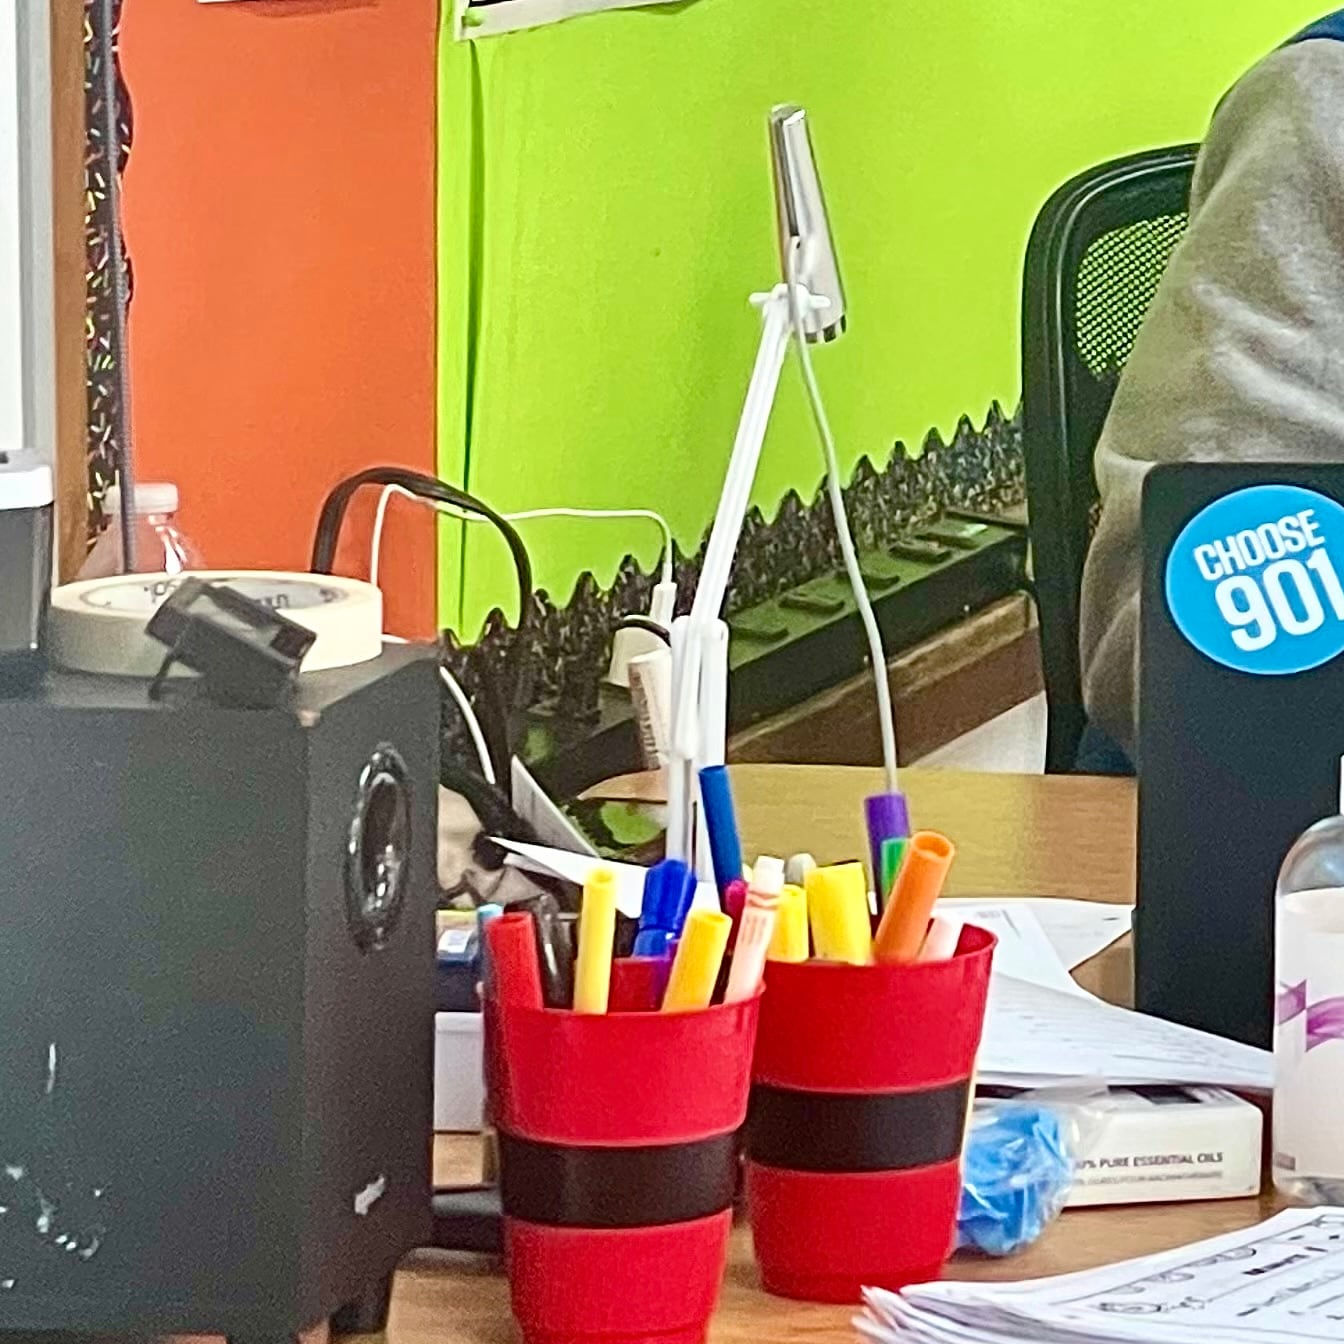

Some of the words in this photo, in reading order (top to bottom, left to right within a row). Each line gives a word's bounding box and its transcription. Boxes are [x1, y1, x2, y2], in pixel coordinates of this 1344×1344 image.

[1193, 508, 1326, 581] CHOOSE
[1100, 1157, 1129, 1168] PURE
[1133, 1155, 1194, 1167] ESSENTIAL
[1197, 1152, 1223, 1163] OILS
